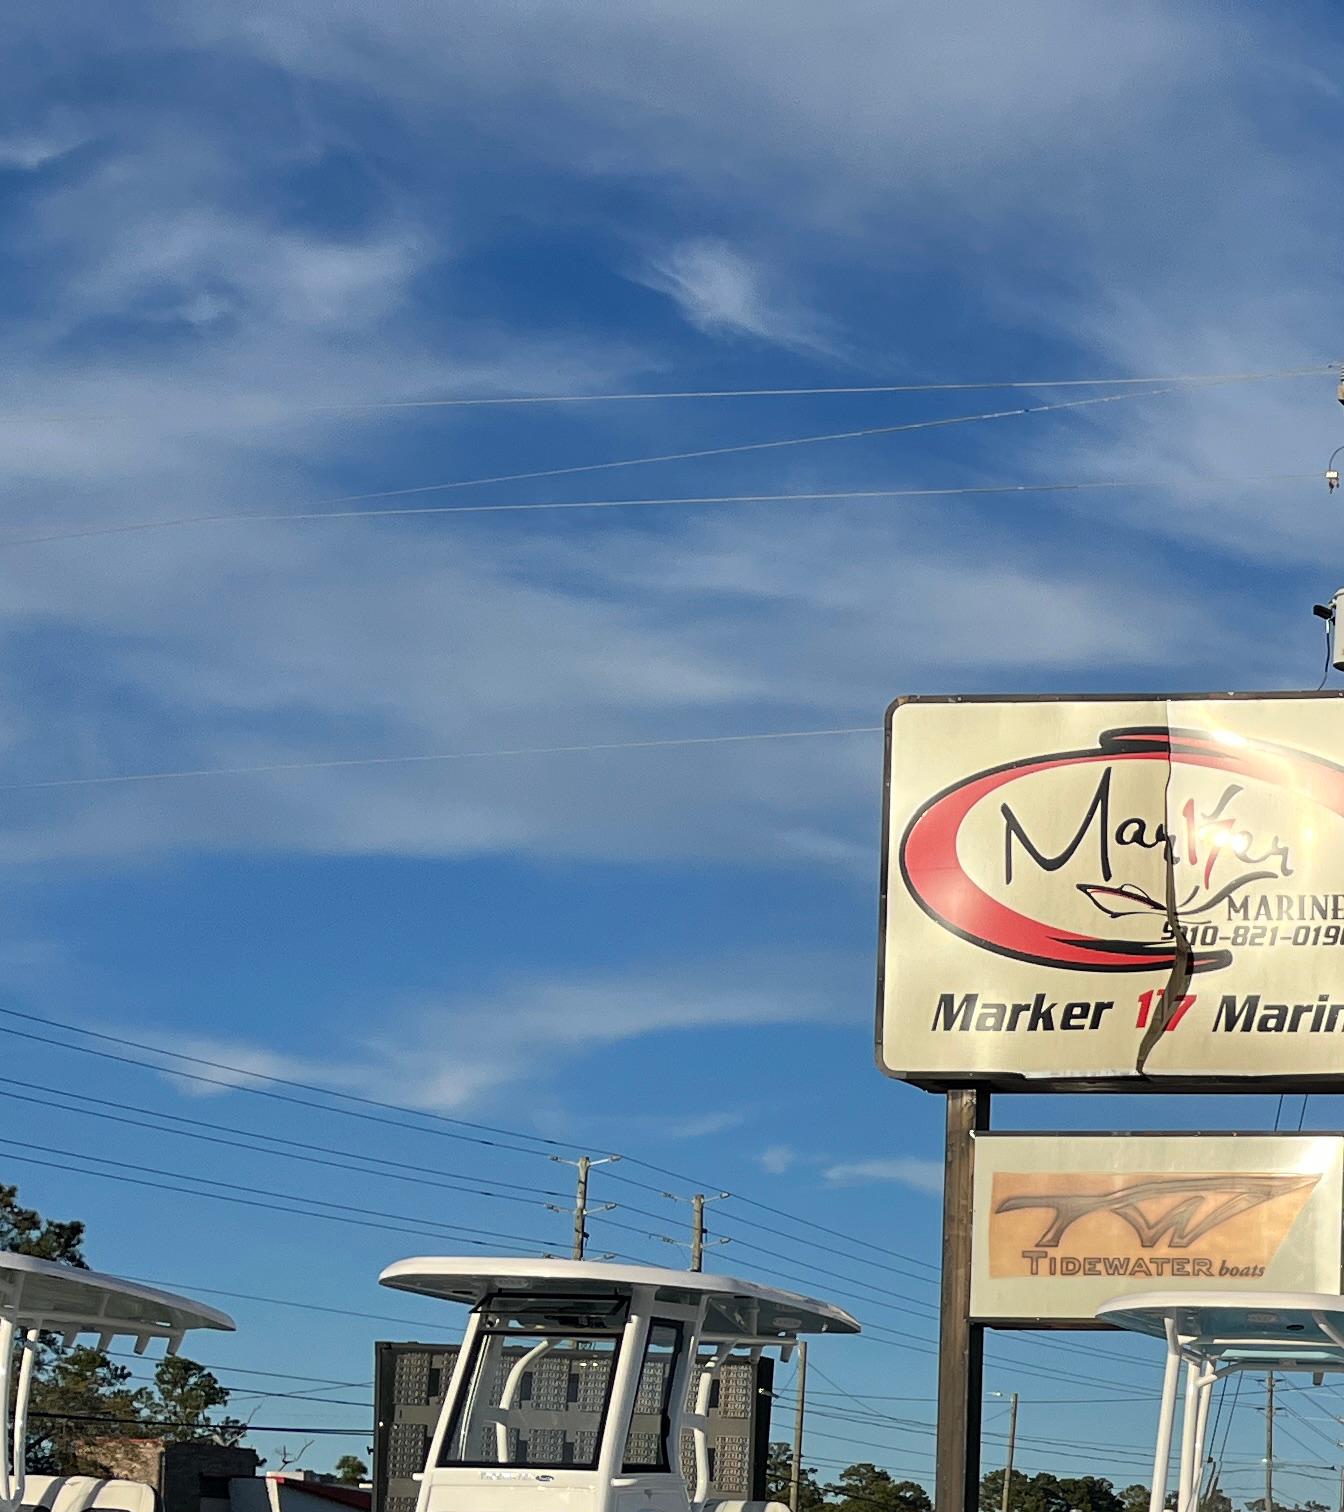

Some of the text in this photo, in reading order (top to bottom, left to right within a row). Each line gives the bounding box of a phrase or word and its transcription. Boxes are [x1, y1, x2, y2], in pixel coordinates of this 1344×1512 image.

[931, 992, 1115, 1034] Marker
[1135, 989, 1198, 1033] 17
[1022, 1250, 1265, 1278] TIDEWATER boats
